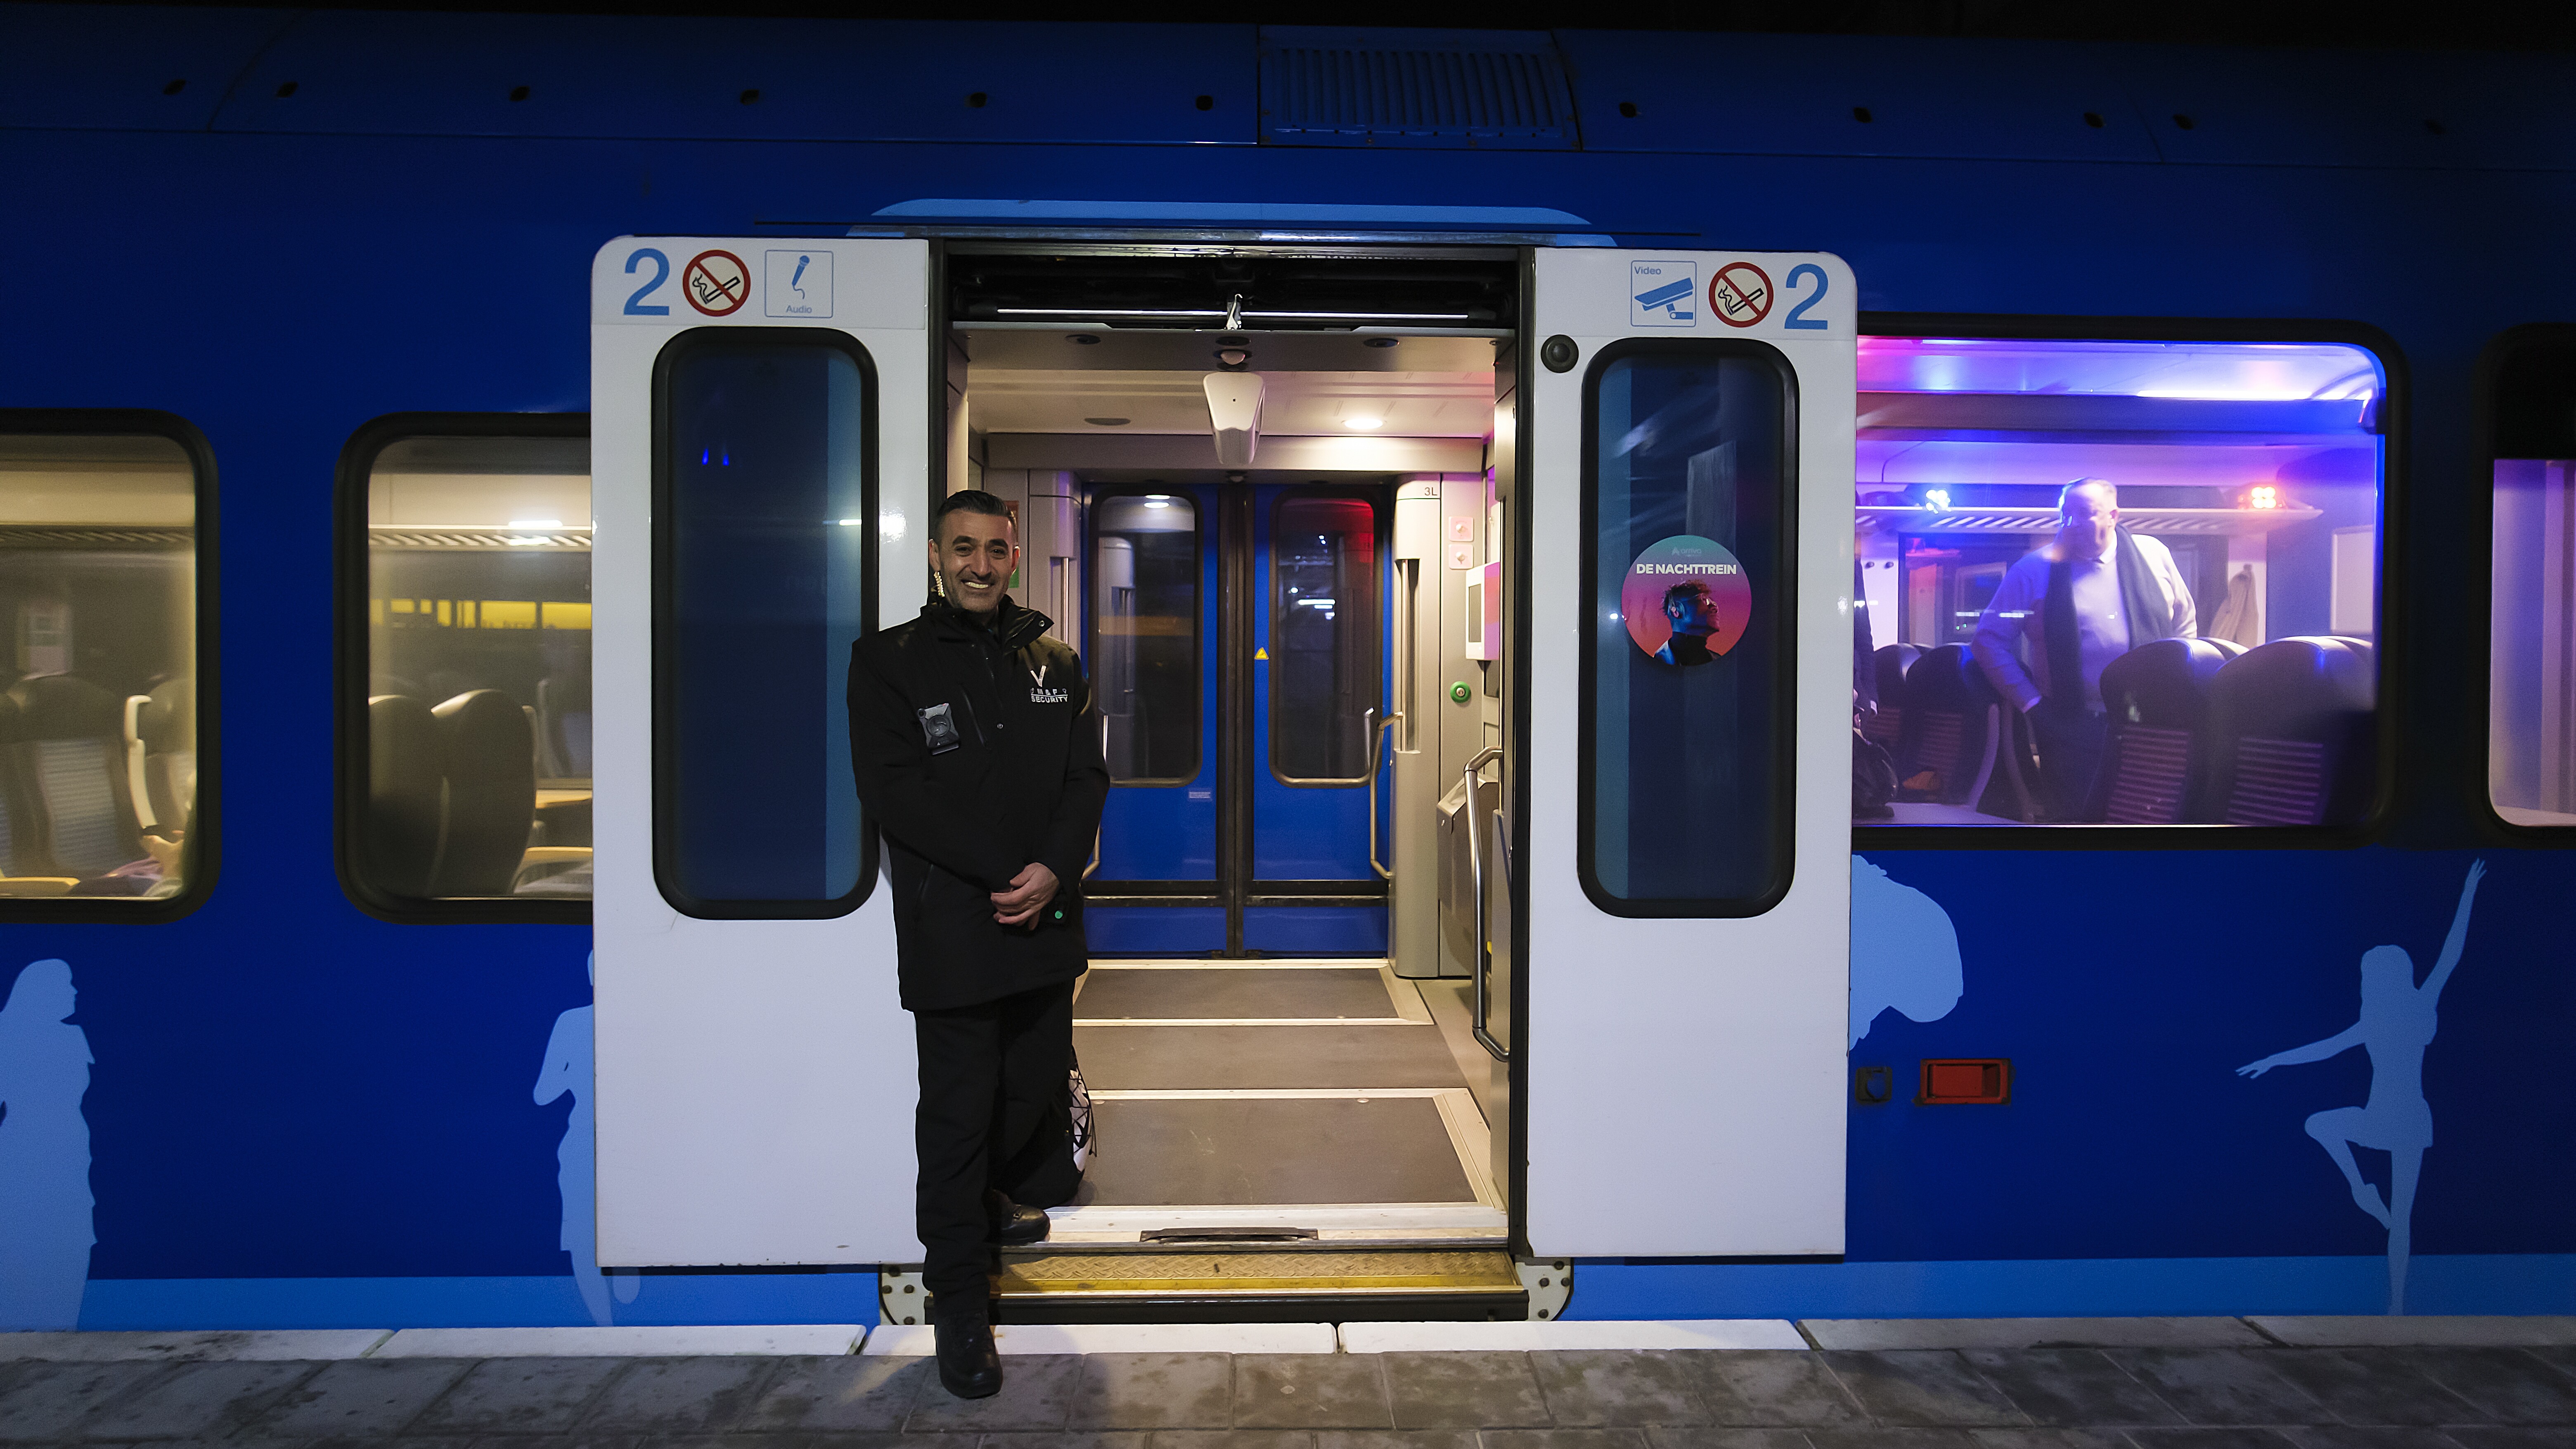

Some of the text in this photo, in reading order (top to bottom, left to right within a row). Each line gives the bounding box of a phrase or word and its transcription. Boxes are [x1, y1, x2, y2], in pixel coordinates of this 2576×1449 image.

[1634, 266, 1662, 276] Video
[623, 248, 670, 316] 2
[1784, 263, 1829, 331] 2
[786, 305, 812, 314] Audio
[1425, 487, 1438, 496] 3L
[1636, 564, 1736, 574] DE NACHTTREIN
